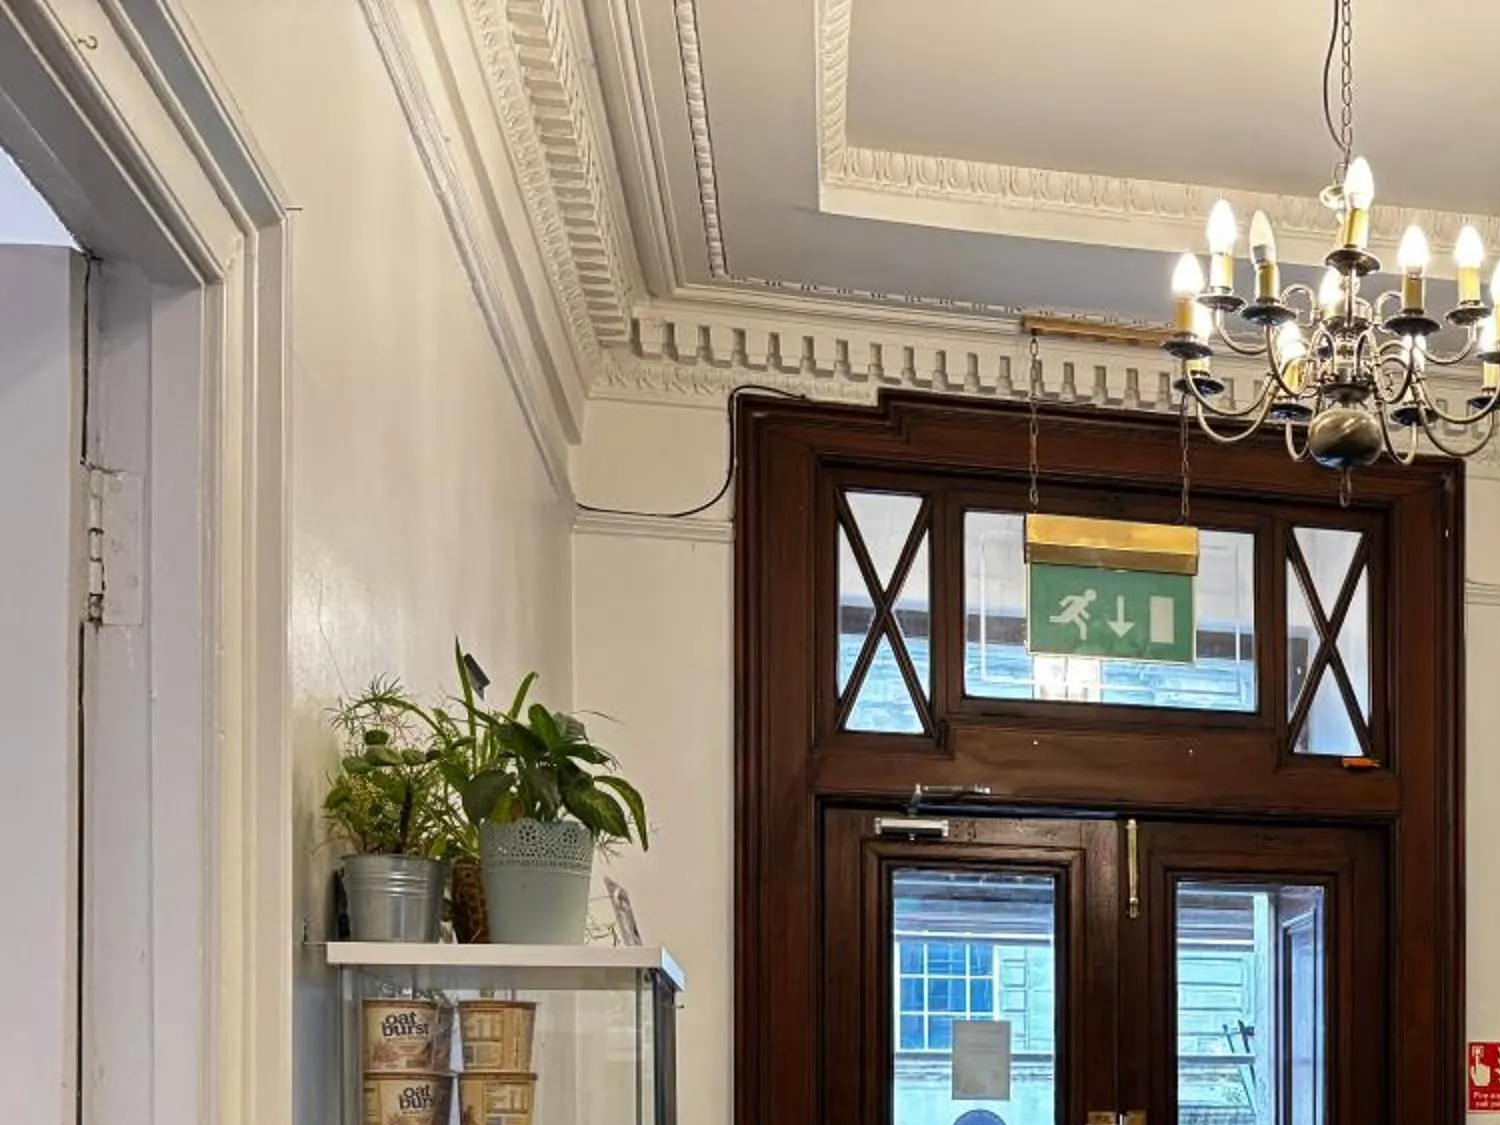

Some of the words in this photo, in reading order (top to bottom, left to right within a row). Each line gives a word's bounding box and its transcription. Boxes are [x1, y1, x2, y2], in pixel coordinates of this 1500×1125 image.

[385, 1011, 417, 1025] oat
[382, 1021, 430, 1037] burst
[403, 1084, 431, 1098] oat
